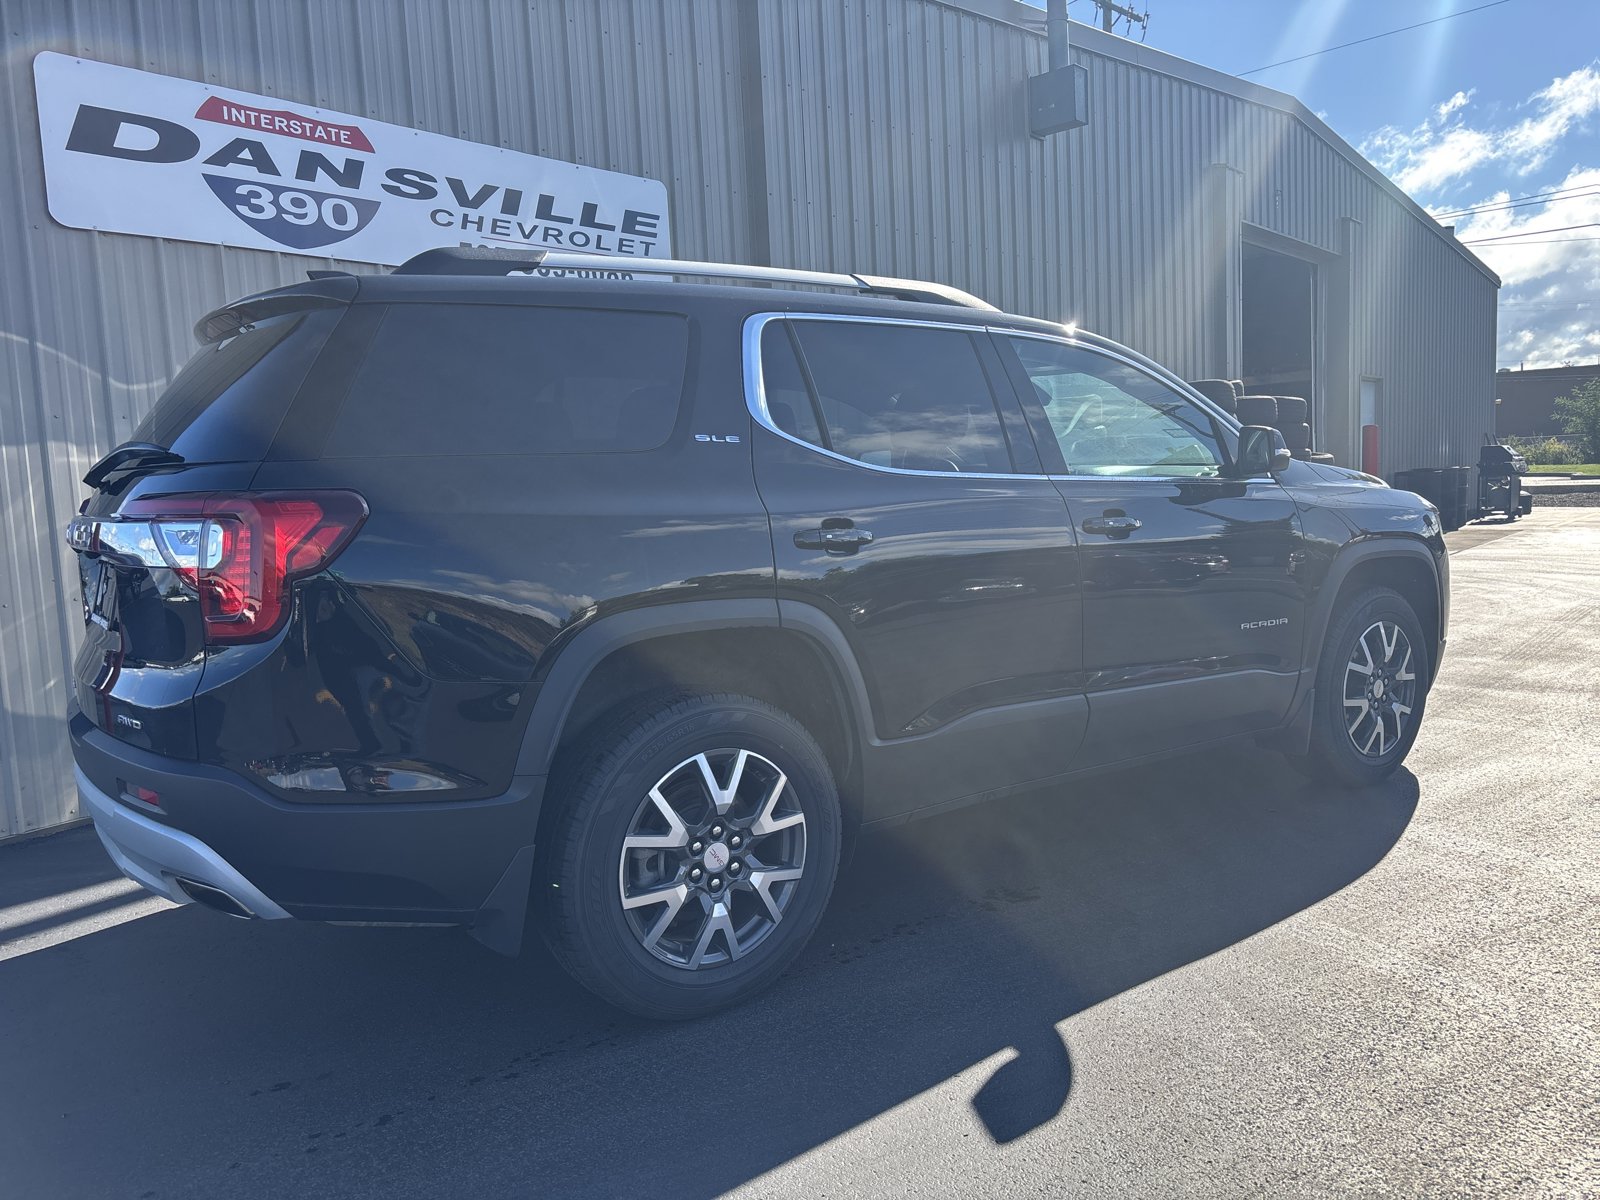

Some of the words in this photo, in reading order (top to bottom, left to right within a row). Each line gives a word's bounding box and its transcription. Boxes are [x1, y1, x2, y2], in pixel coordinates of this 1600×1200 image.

[222, 105, 352, 145] INTERSTATE
[65, 103, 660, 238] DANSVILLE
[235, 184, 359, 231] 390
[429, 208, 656, 256] CHEVROLET
[694, 434, 741, 443] SLE
[1240, 617, 1288, 630] ACADIA
[117, 714, 142, 730] AWD
[709, 848, 725, 866] GMC
